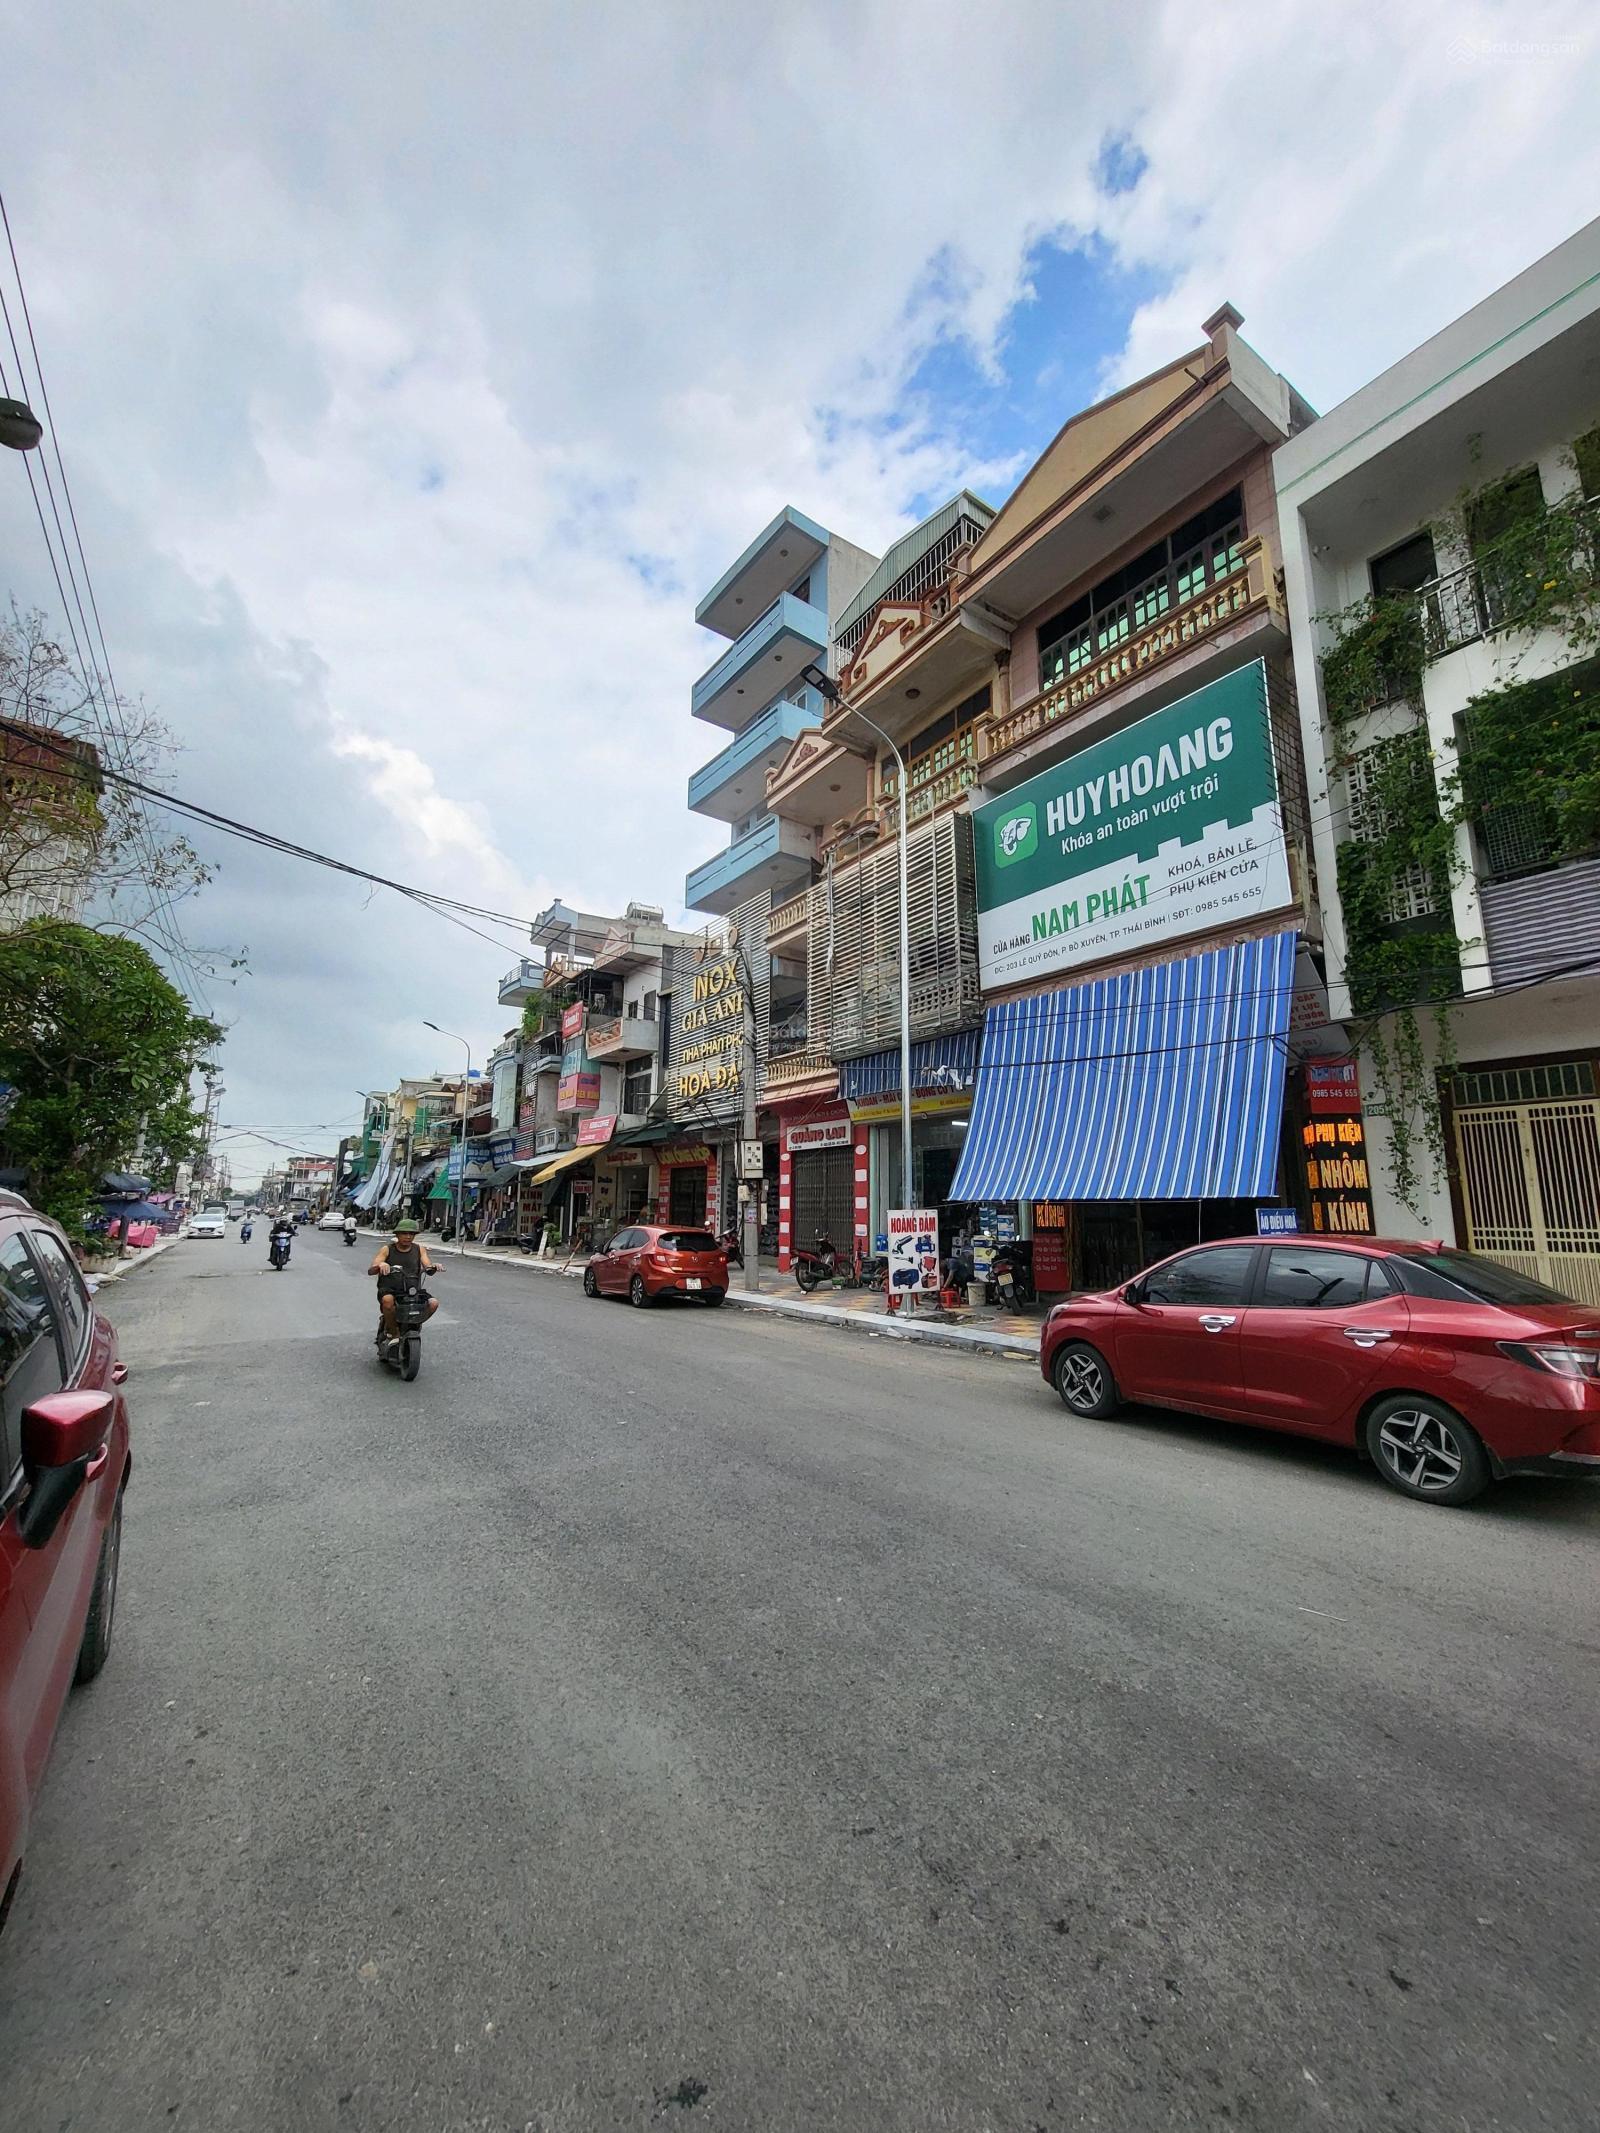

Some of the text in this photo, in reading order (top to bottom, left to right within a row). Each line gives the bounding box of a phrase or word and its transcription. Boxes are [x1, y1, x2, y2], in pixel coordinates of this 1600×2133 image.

[1061, 773, 1219, 855] Khóa an toàn vượt trội
[1208, 846, 1234, 863] BẢN
[1170, 859, 1258, 896] PHỤ KIỆN CỬA
[993, 874, 1150, 955] CỬA HÀNG NAM PHÁT
[1006, 962, 1018, 972] 203
[1122, 922, 1142, 935] THÁI
[1144, 914, 1166, 929] BÌNH
[1196, 899, 1219, 914] 0985
[1221, 892, 1241, 905] 545
[1242, 886, 1262, 899] 655
[693, 957, 738, 1003] INOX
[682, 1006, 709, 1030] GIA
[825, 1126, 846, 1141] LAN
[1315, 1123, 1336, 1147] PHỤ
[1337, 1118, 1363, 1146] KIỆN
[1320, 1151, 1368, 1189] NHÔM
[1327, 1194, 1370, 1231] KÍNH
